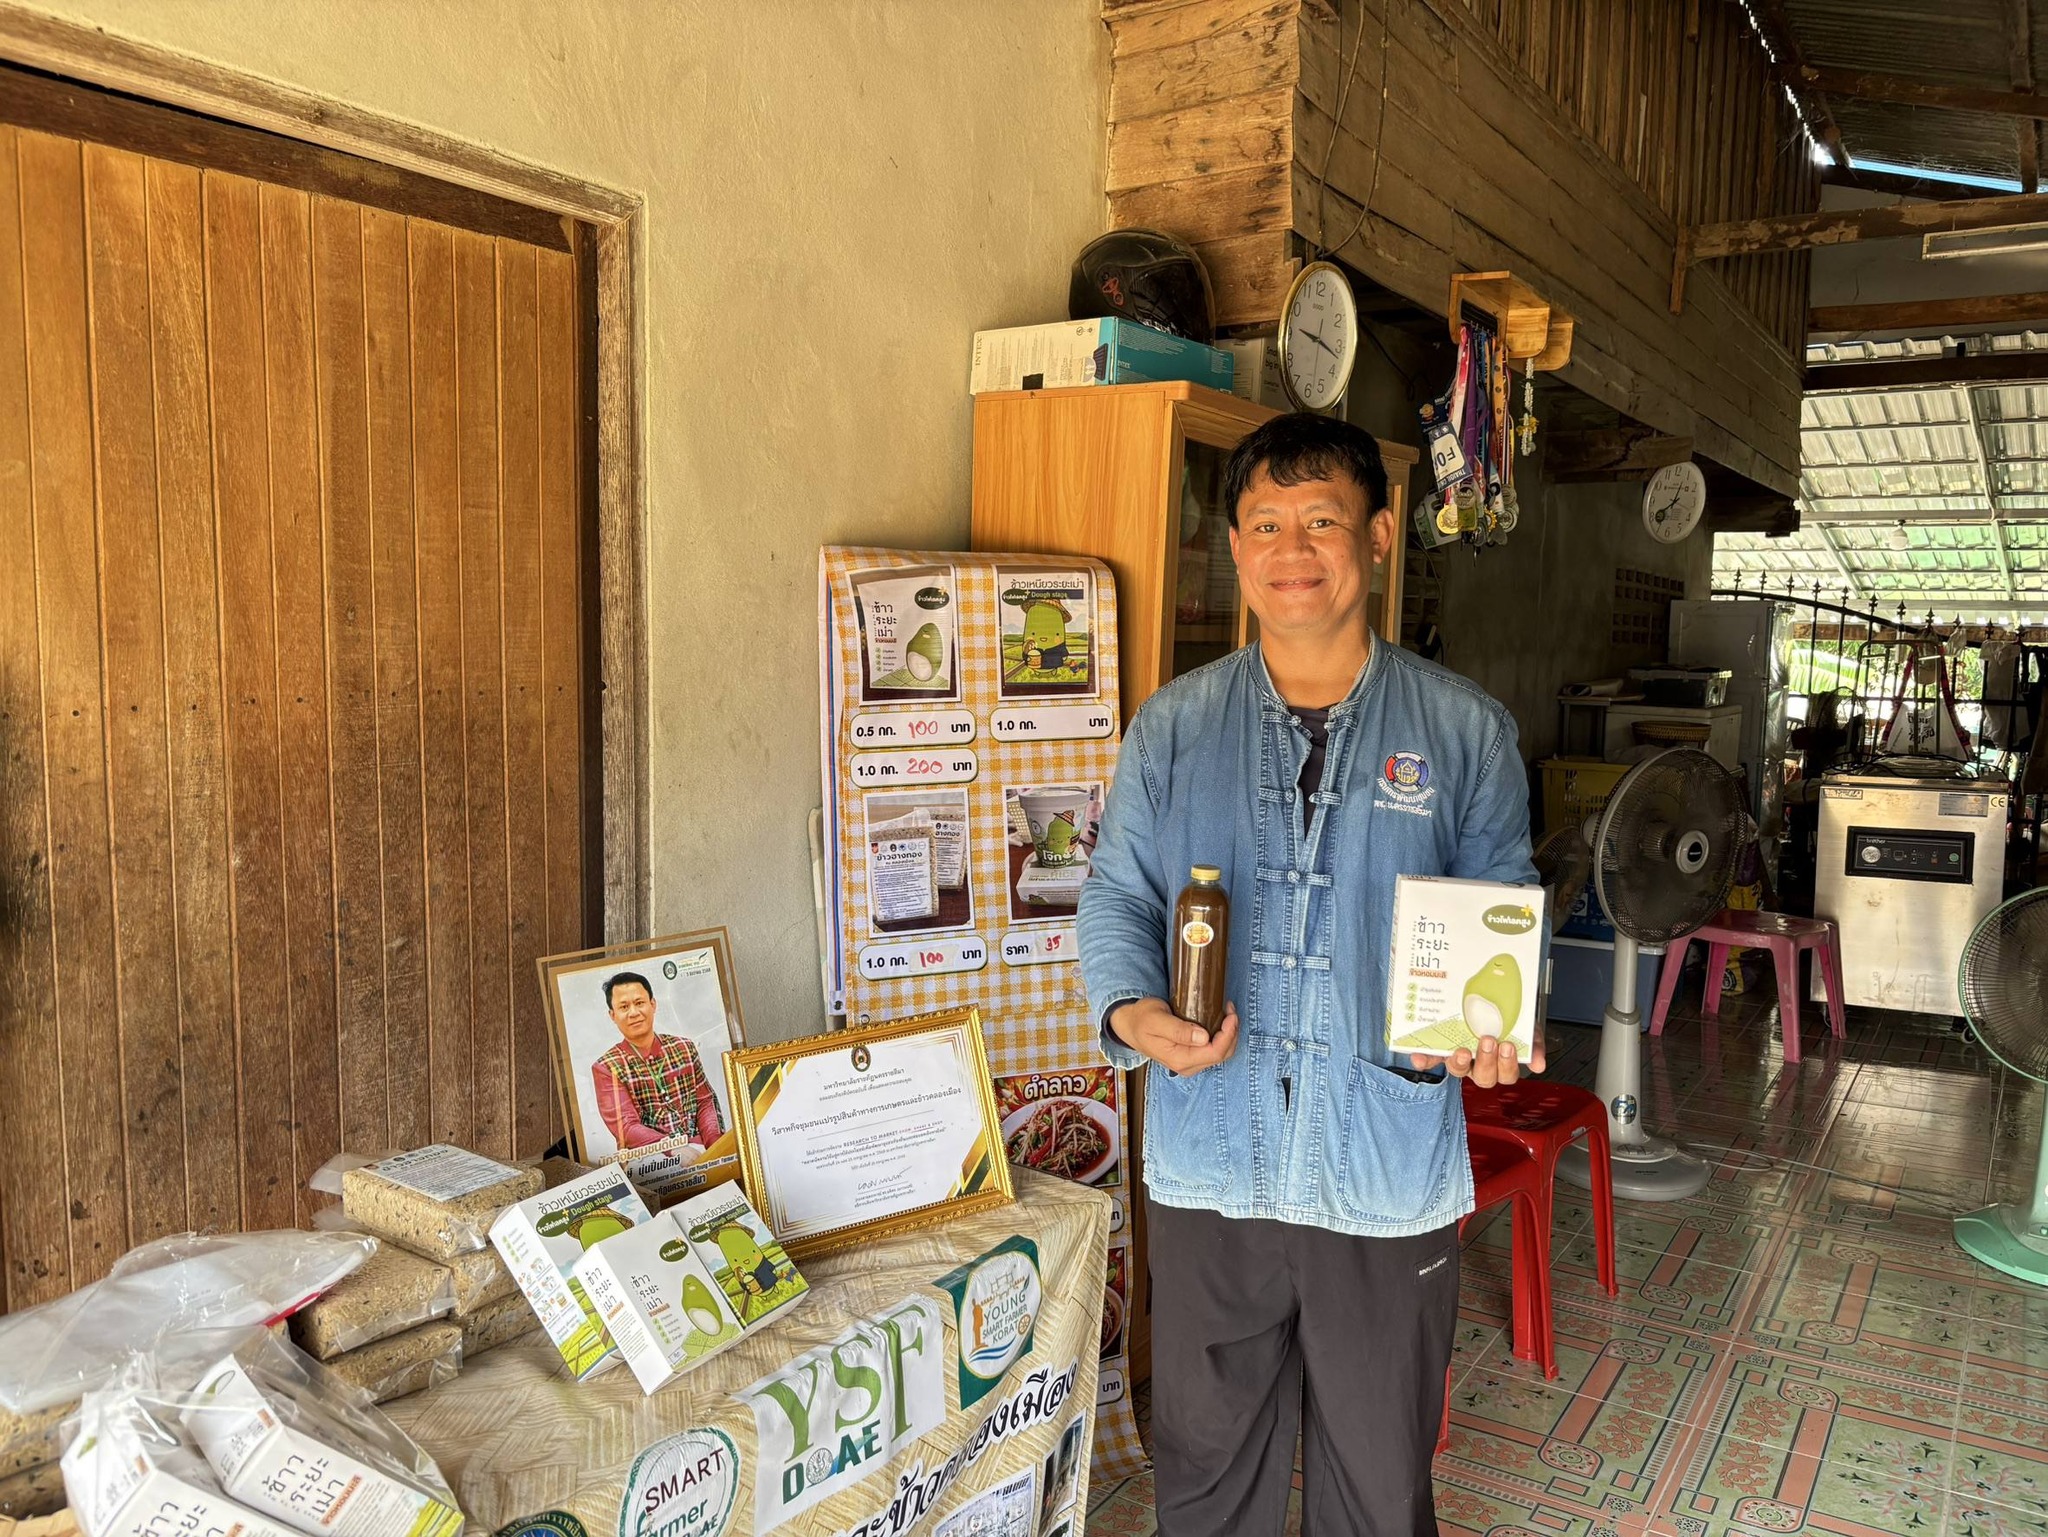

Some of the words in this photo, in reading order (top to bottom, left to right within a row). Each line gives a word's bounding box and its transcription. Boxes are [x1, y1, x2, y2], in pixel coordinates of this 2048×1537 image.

[1304, 283, 1312, 299] 11
[1316, 282, 1326, 297] 12
[1334, 313, 1341, 328] 2
[1335, 339, 1342, 354] 3
[1328, 363, 1336, 378] 4
[1304, 383, 1312, 399] 6
[1316, 378, 1325, 394] 5
[874, 601, 893, 613] ข้าว
[876, 616, 897, 625] ระยะ
[878, 626, 893, 637] เม่า
[856, 726, 875, 738] 0.5
[878, 725, 897, 736] กก.
[907, 720, 939, 738] 100
[951, 723, 971, 733] บาท
[997, 720, 1015, 731] 1.0
[1019, 720, 1037, 731] กก.
[1089, 717, 1109, 727] บาท
[857, 765, 876, 777] 1.0
[880, 764, 899, 775] กก.
[906, 758, 943, 775] 200
[953, 760, 972, 771] บาท
[1417, 915, 1445, 934] ข้าว
[1006, 944, 1029, 956] ราคา
[1416, 938, 1449, 951] ระยะ
[866, 957, 885, 969] 1.0
[889, 957, 908, 968] กก.
[919, 951, 944, 968] 100
[962, 949, 982, 960] บาท
[1416, 952, 1440, 969] เม่า
[1024, 1074, 1087, 1100] ตำลาว
[538, 1171, 624, 1215] ข้าวเหนียวระยะเม่า
[571, 1202, 595, 1216] Dough
[594, 1193, 613, 1205] stage
[630, 1274, 650, 1288] ข้าว
[639, 1285, 659, 1298] ระยะ
[646, 1296, 663, 1310] เม่า
[984, 1290, 1026, 1326] YOUNG
[983, 1320, 1004, 1339] SMART
[1004, 1304, 1028, 1325] FARMER
[992, 1319, 1018, 1344] KORAT
[752, 1303, 926, 1465] YSF
[1102, 1380, 1120, 1393] บาท
[262, 1454, 304, 1493] ข้าว
[289, 1457, 330, 1503] ระยะ
[645, 1447, 724, 1513] SMART
[311, 1478, 345, 1514] เม่า
